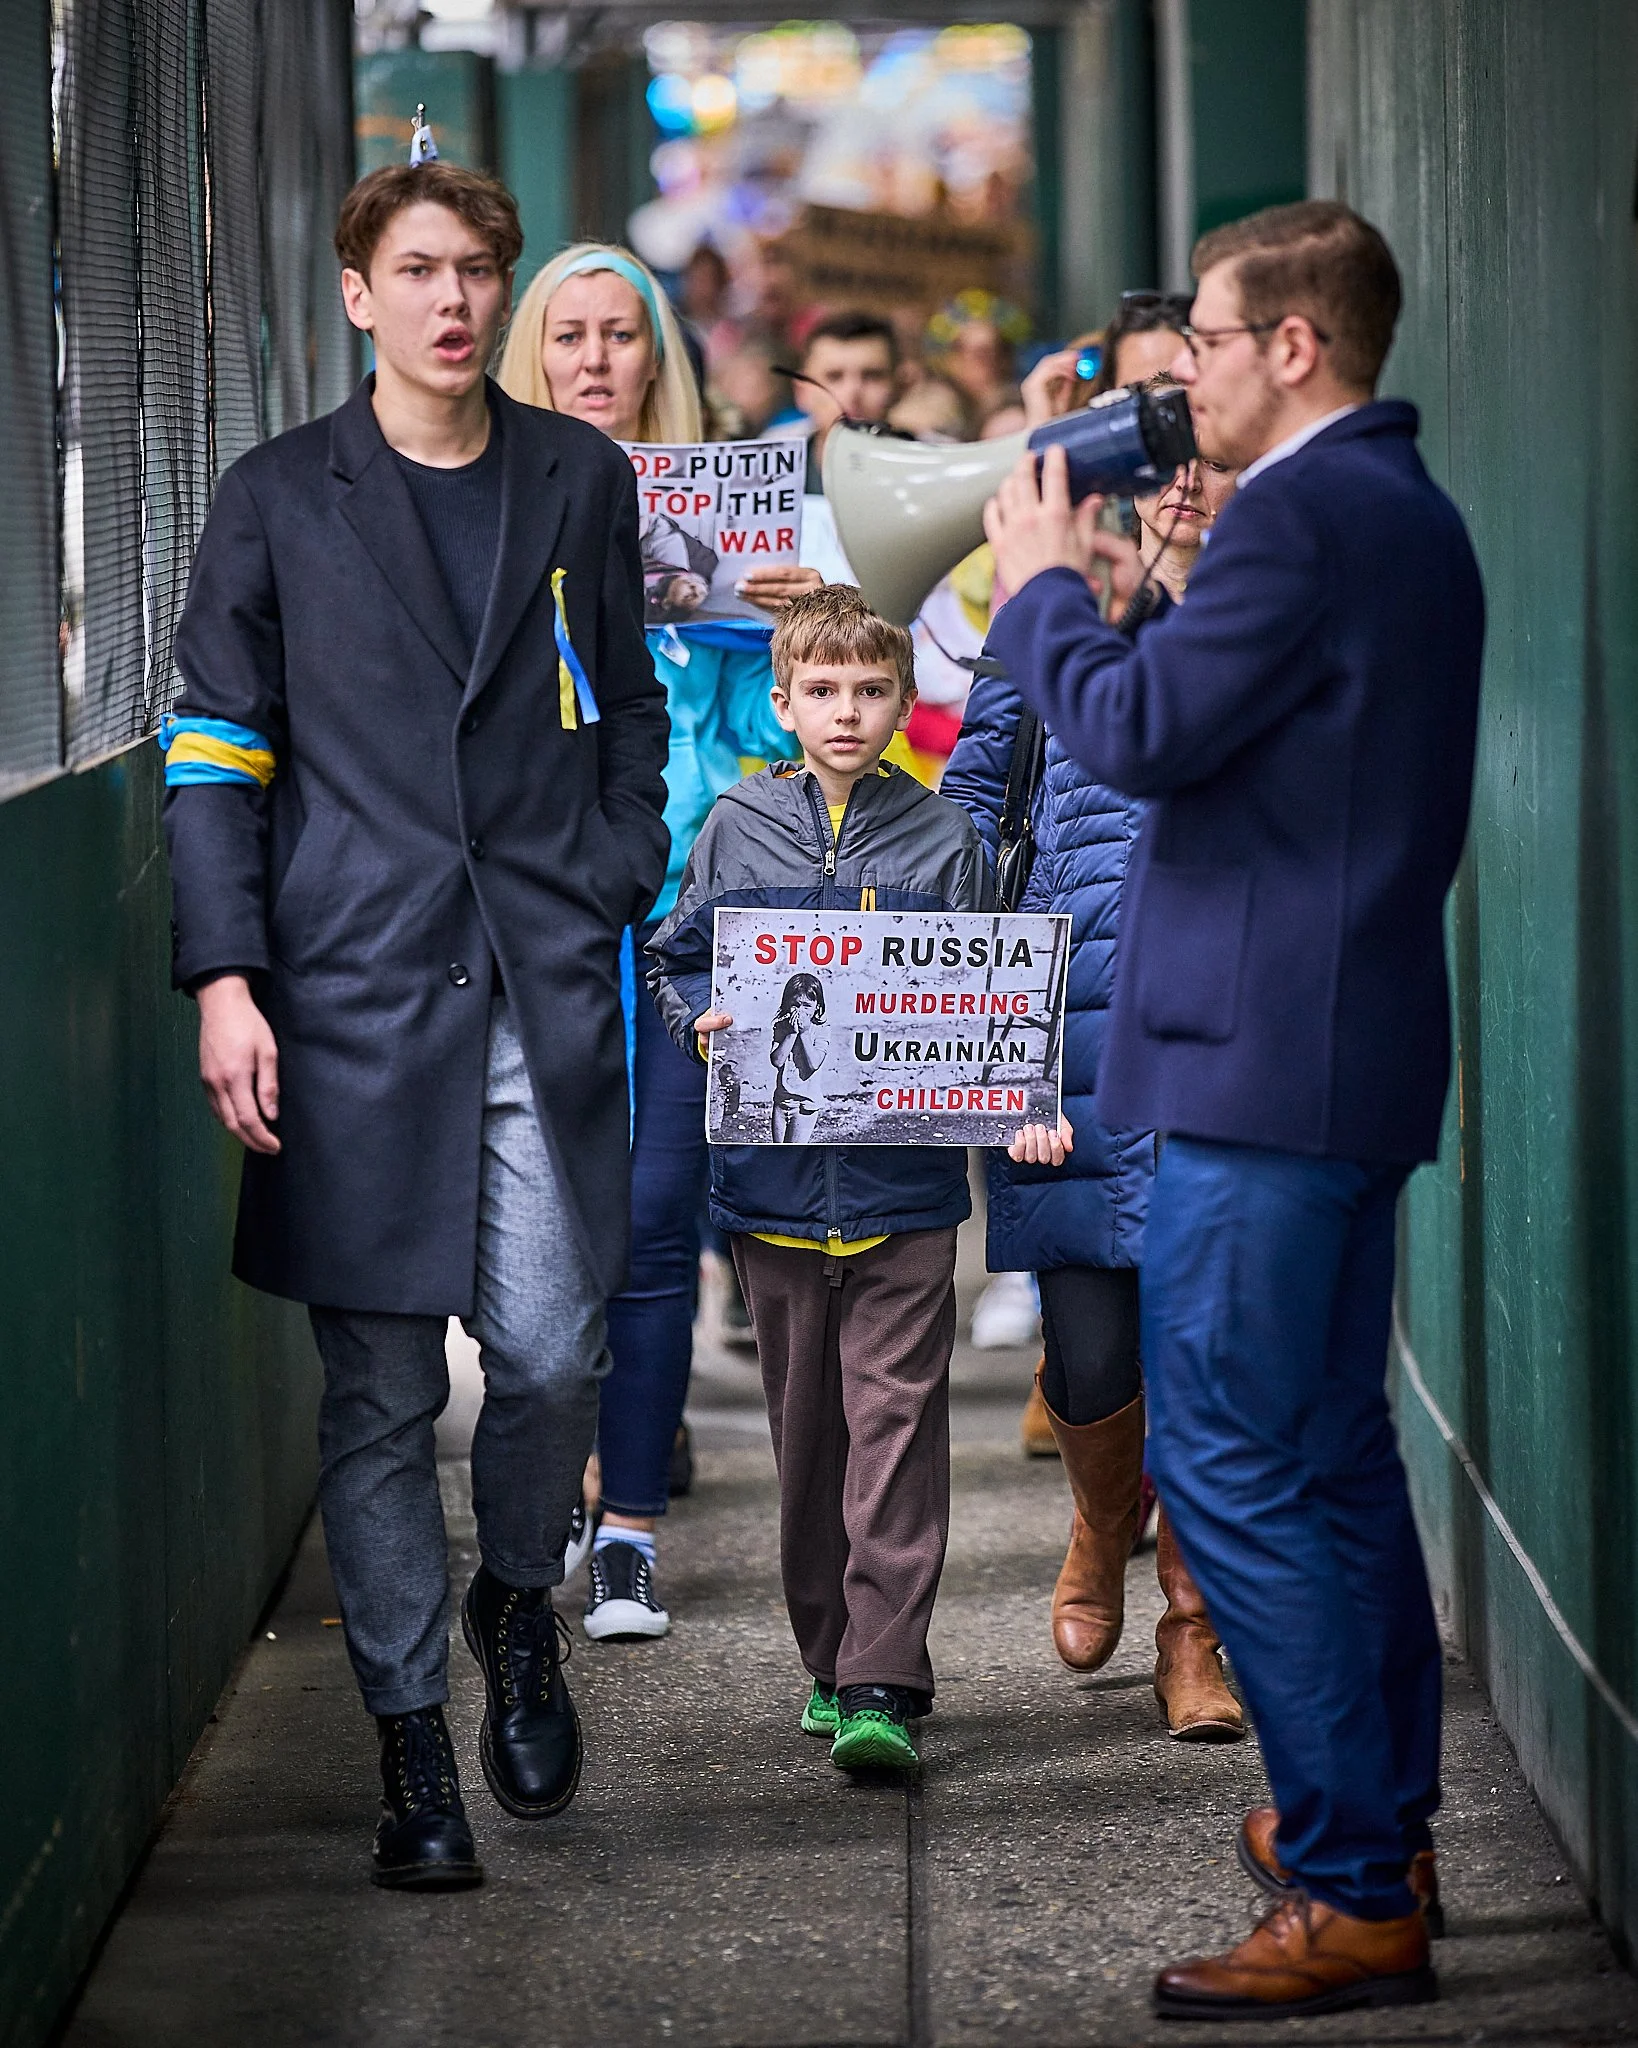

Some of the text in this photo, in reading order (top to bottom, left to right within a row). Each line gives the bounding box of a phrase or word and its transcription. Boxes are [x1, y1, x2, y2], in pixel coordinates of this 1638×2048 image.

[630, 451, 794, 478] OP PUTIN
[643, 490, 794, 516] TOP THE
[720, 528, 793, 553] WAR
[755, 934, 1033, 967] STOP RUSSIA
[855, 993, 1029, 1015] MURDERING
[854, 1032, 1026, 1062] UKRAINIAN
[877, 1089, 1024, 1111] CHILDREN
